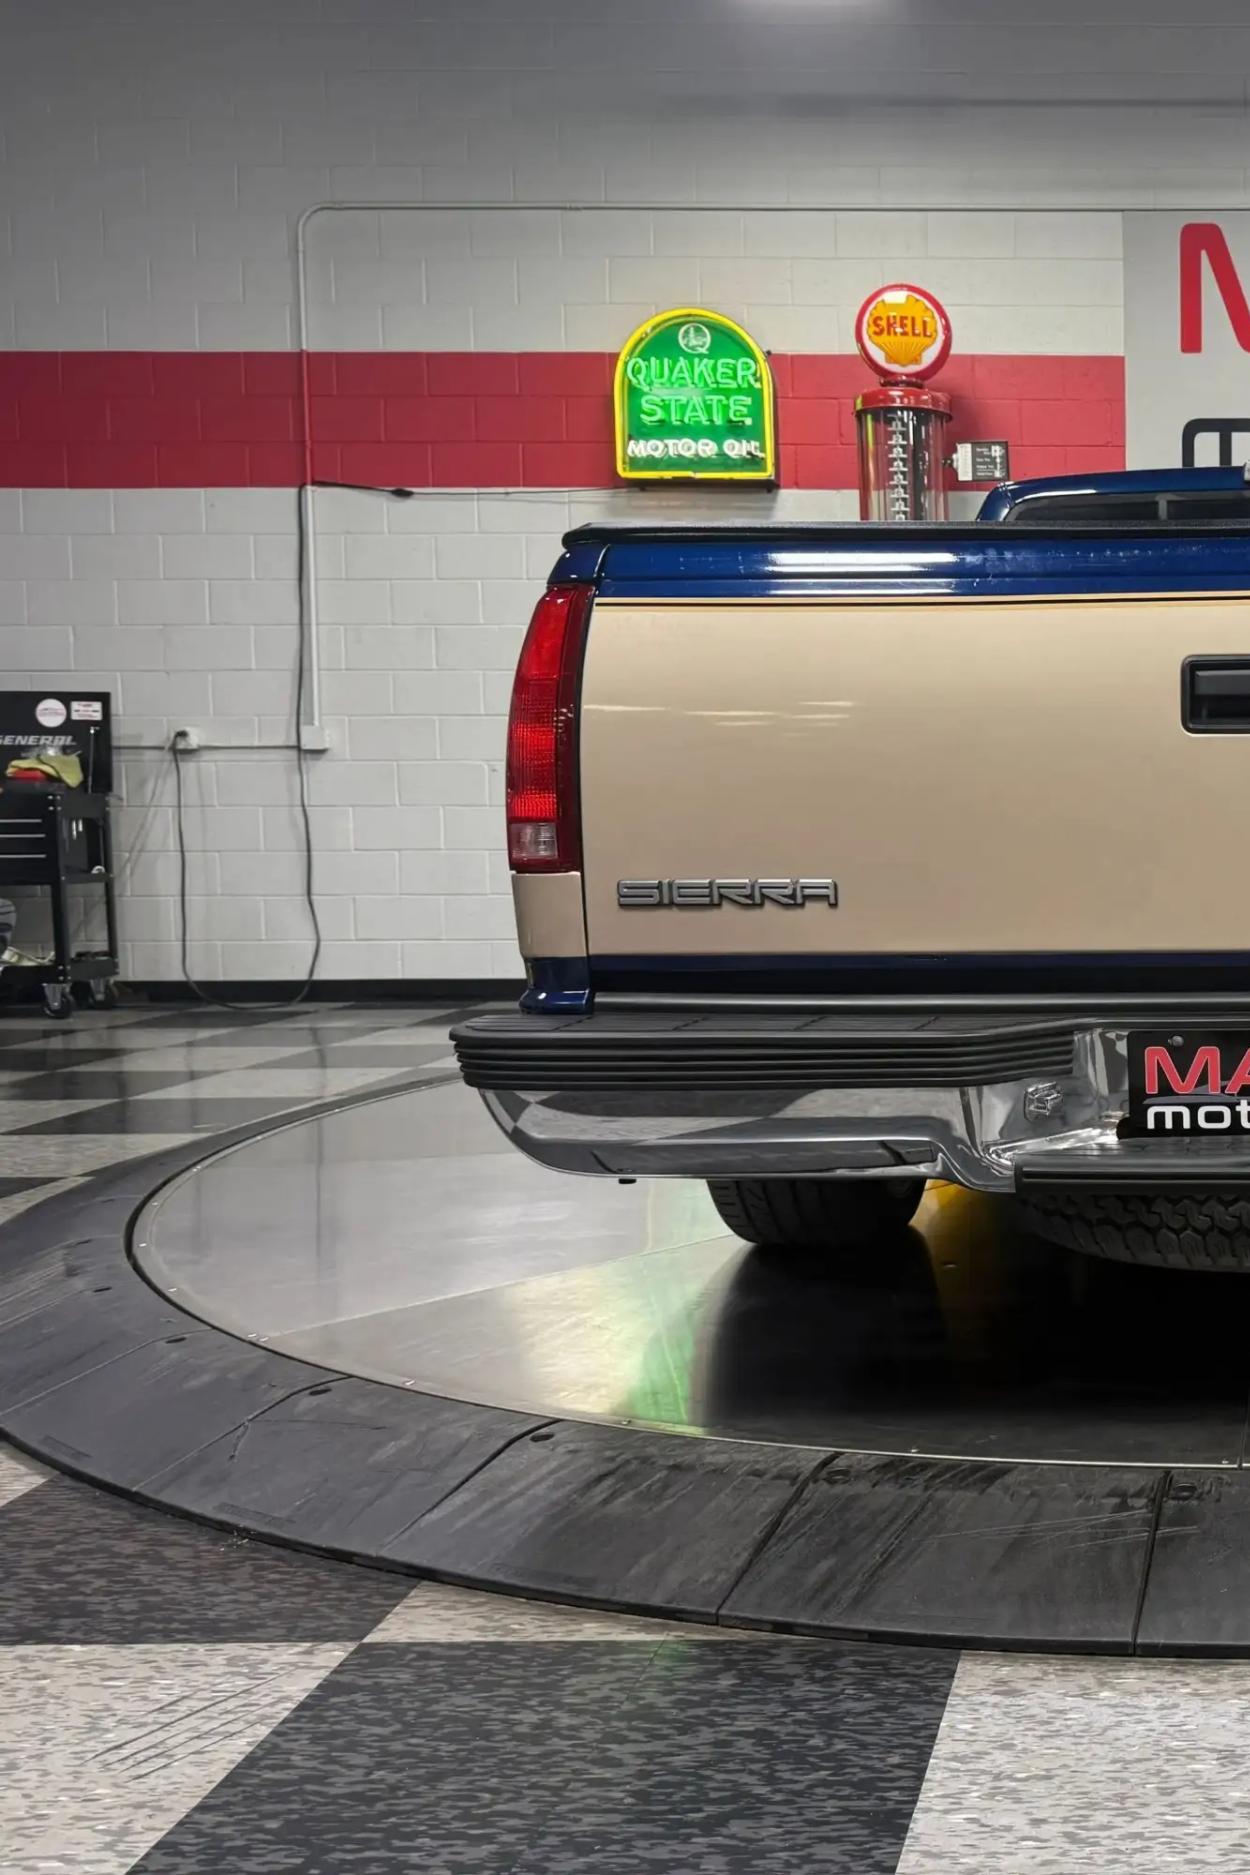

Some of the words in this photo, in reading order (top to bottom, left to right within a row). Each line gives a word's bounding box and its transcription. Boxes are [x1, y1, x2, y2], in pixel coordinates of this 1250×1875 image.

[871, 315, 933, 338] SHELL
[626, 356, 762, 392] QUAKER
[640, 395, 753, 426] STATE
[627, 437, 718, 458] MOTOR
[722, 438, 766, 459] OIL
[617, 878, 838, 907] SIERRA
